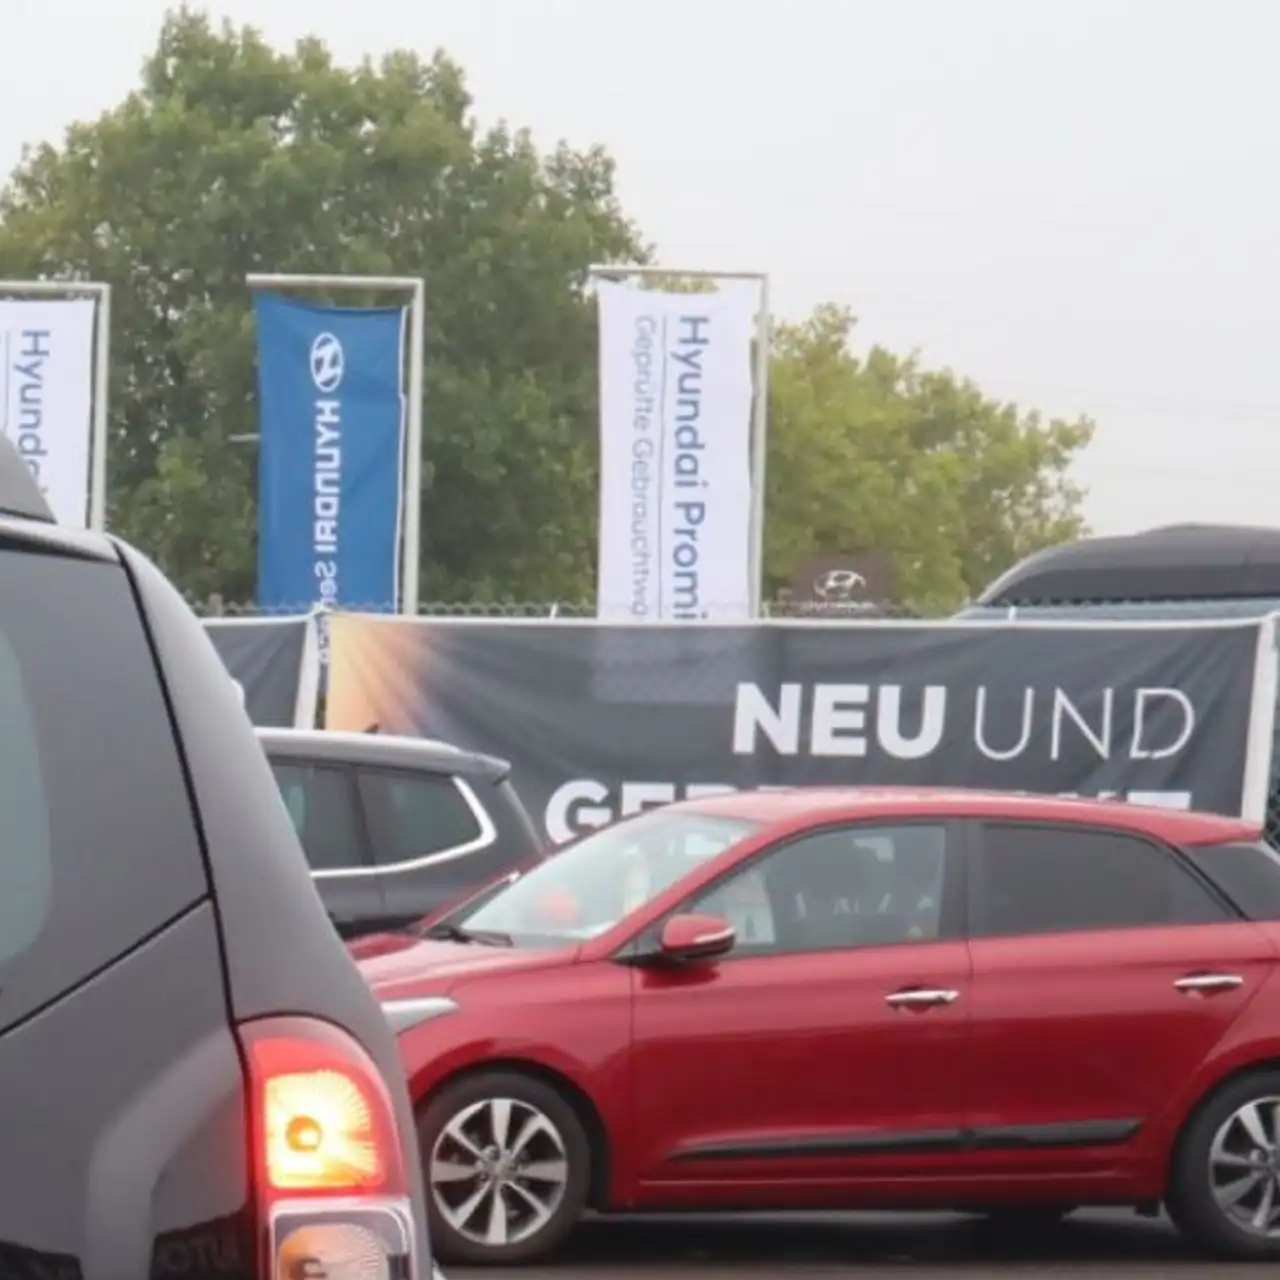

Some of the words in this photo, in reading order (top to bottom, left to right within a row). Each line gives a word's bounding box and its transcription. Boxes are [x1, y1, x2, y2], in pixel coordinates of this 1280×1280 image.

[13, 329, 52, 495] Hyund
[670, 316, 711, 488] Hyundai
[732, 681, 947, 760] NEU
[974, 686, 1196, 761] UND
